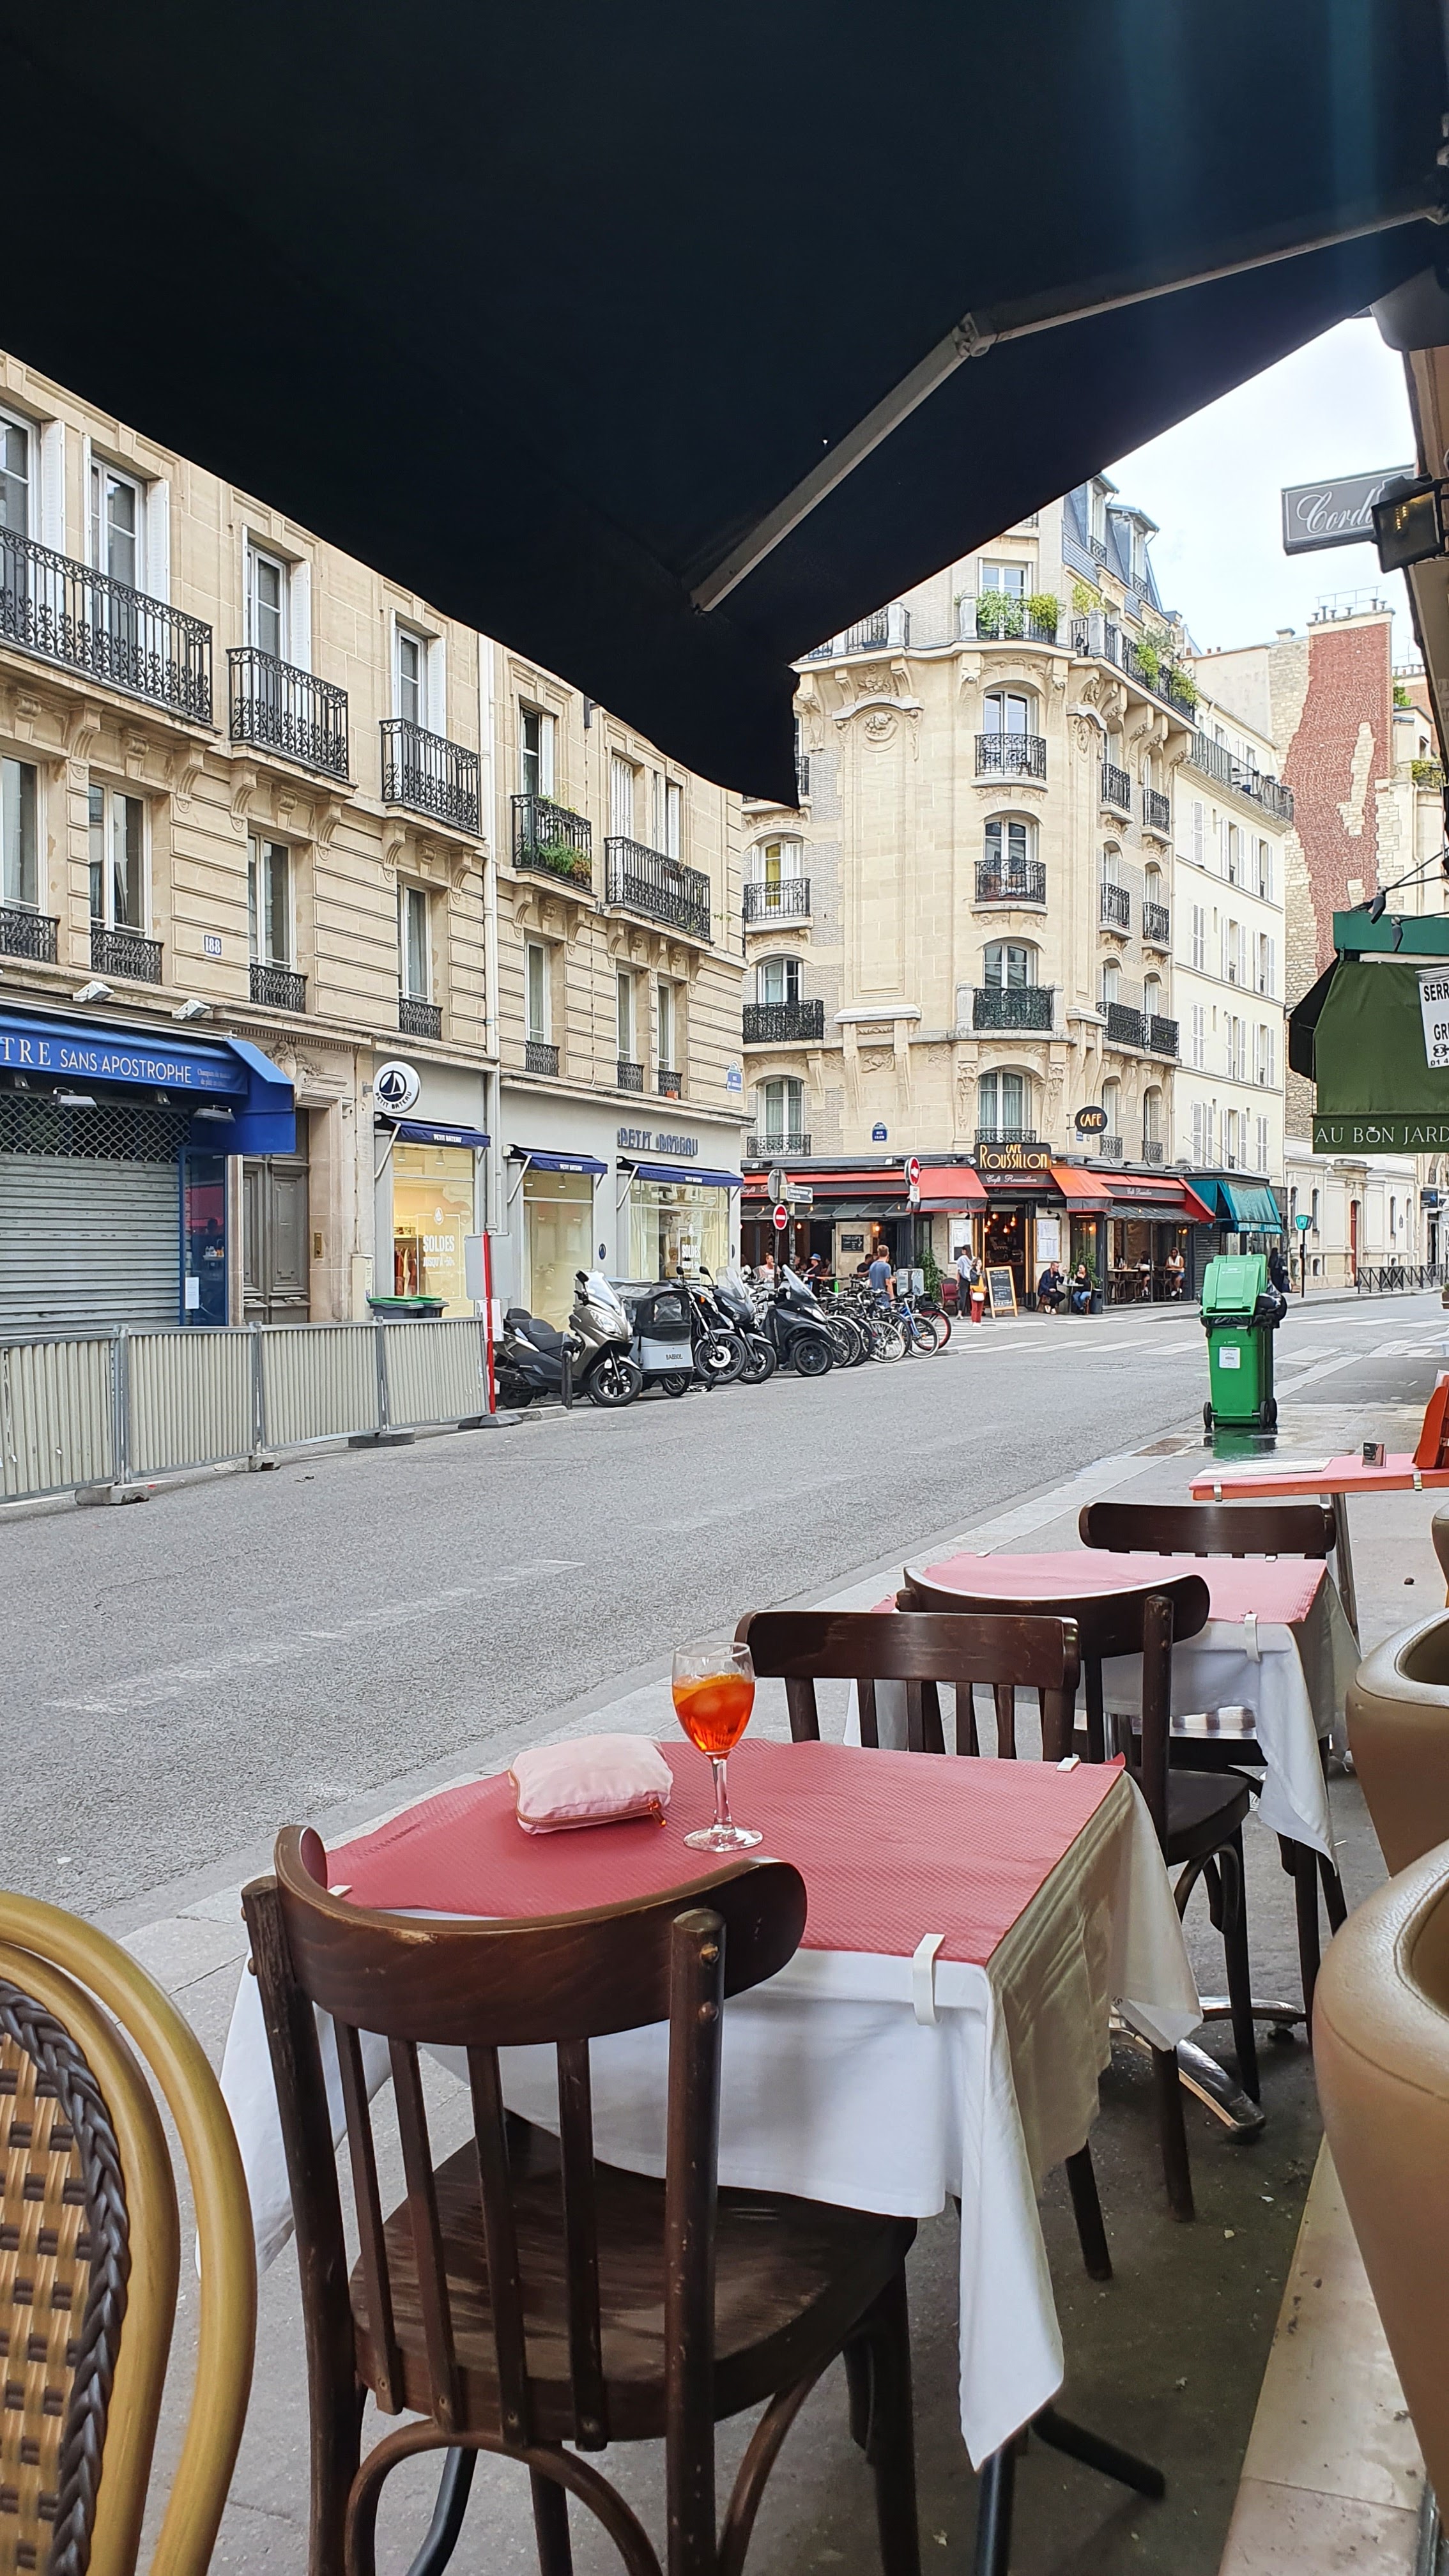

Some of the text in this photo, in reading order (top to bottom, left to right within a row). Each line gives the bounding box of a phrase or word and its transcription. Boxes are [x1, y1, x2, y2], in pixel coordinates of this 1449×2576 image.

[205, 936, 221, 954] 188
[1434, 1023, 1449, 1041] GR
[0, 1036, 192, 1084] TRE SANS APOSTROPHE
[375, 1091, 412, 1109] PETIT BATEAU
[620, 1127, 698, 1156] PETIT BATEAU
[1314, 1127, 1344, 1143] AU
[1353, 1126, 1395, 1143] BON
[423, 1234, 455, 1253] SOLDES
[682, 1244, 701, 1258] SOLDES
